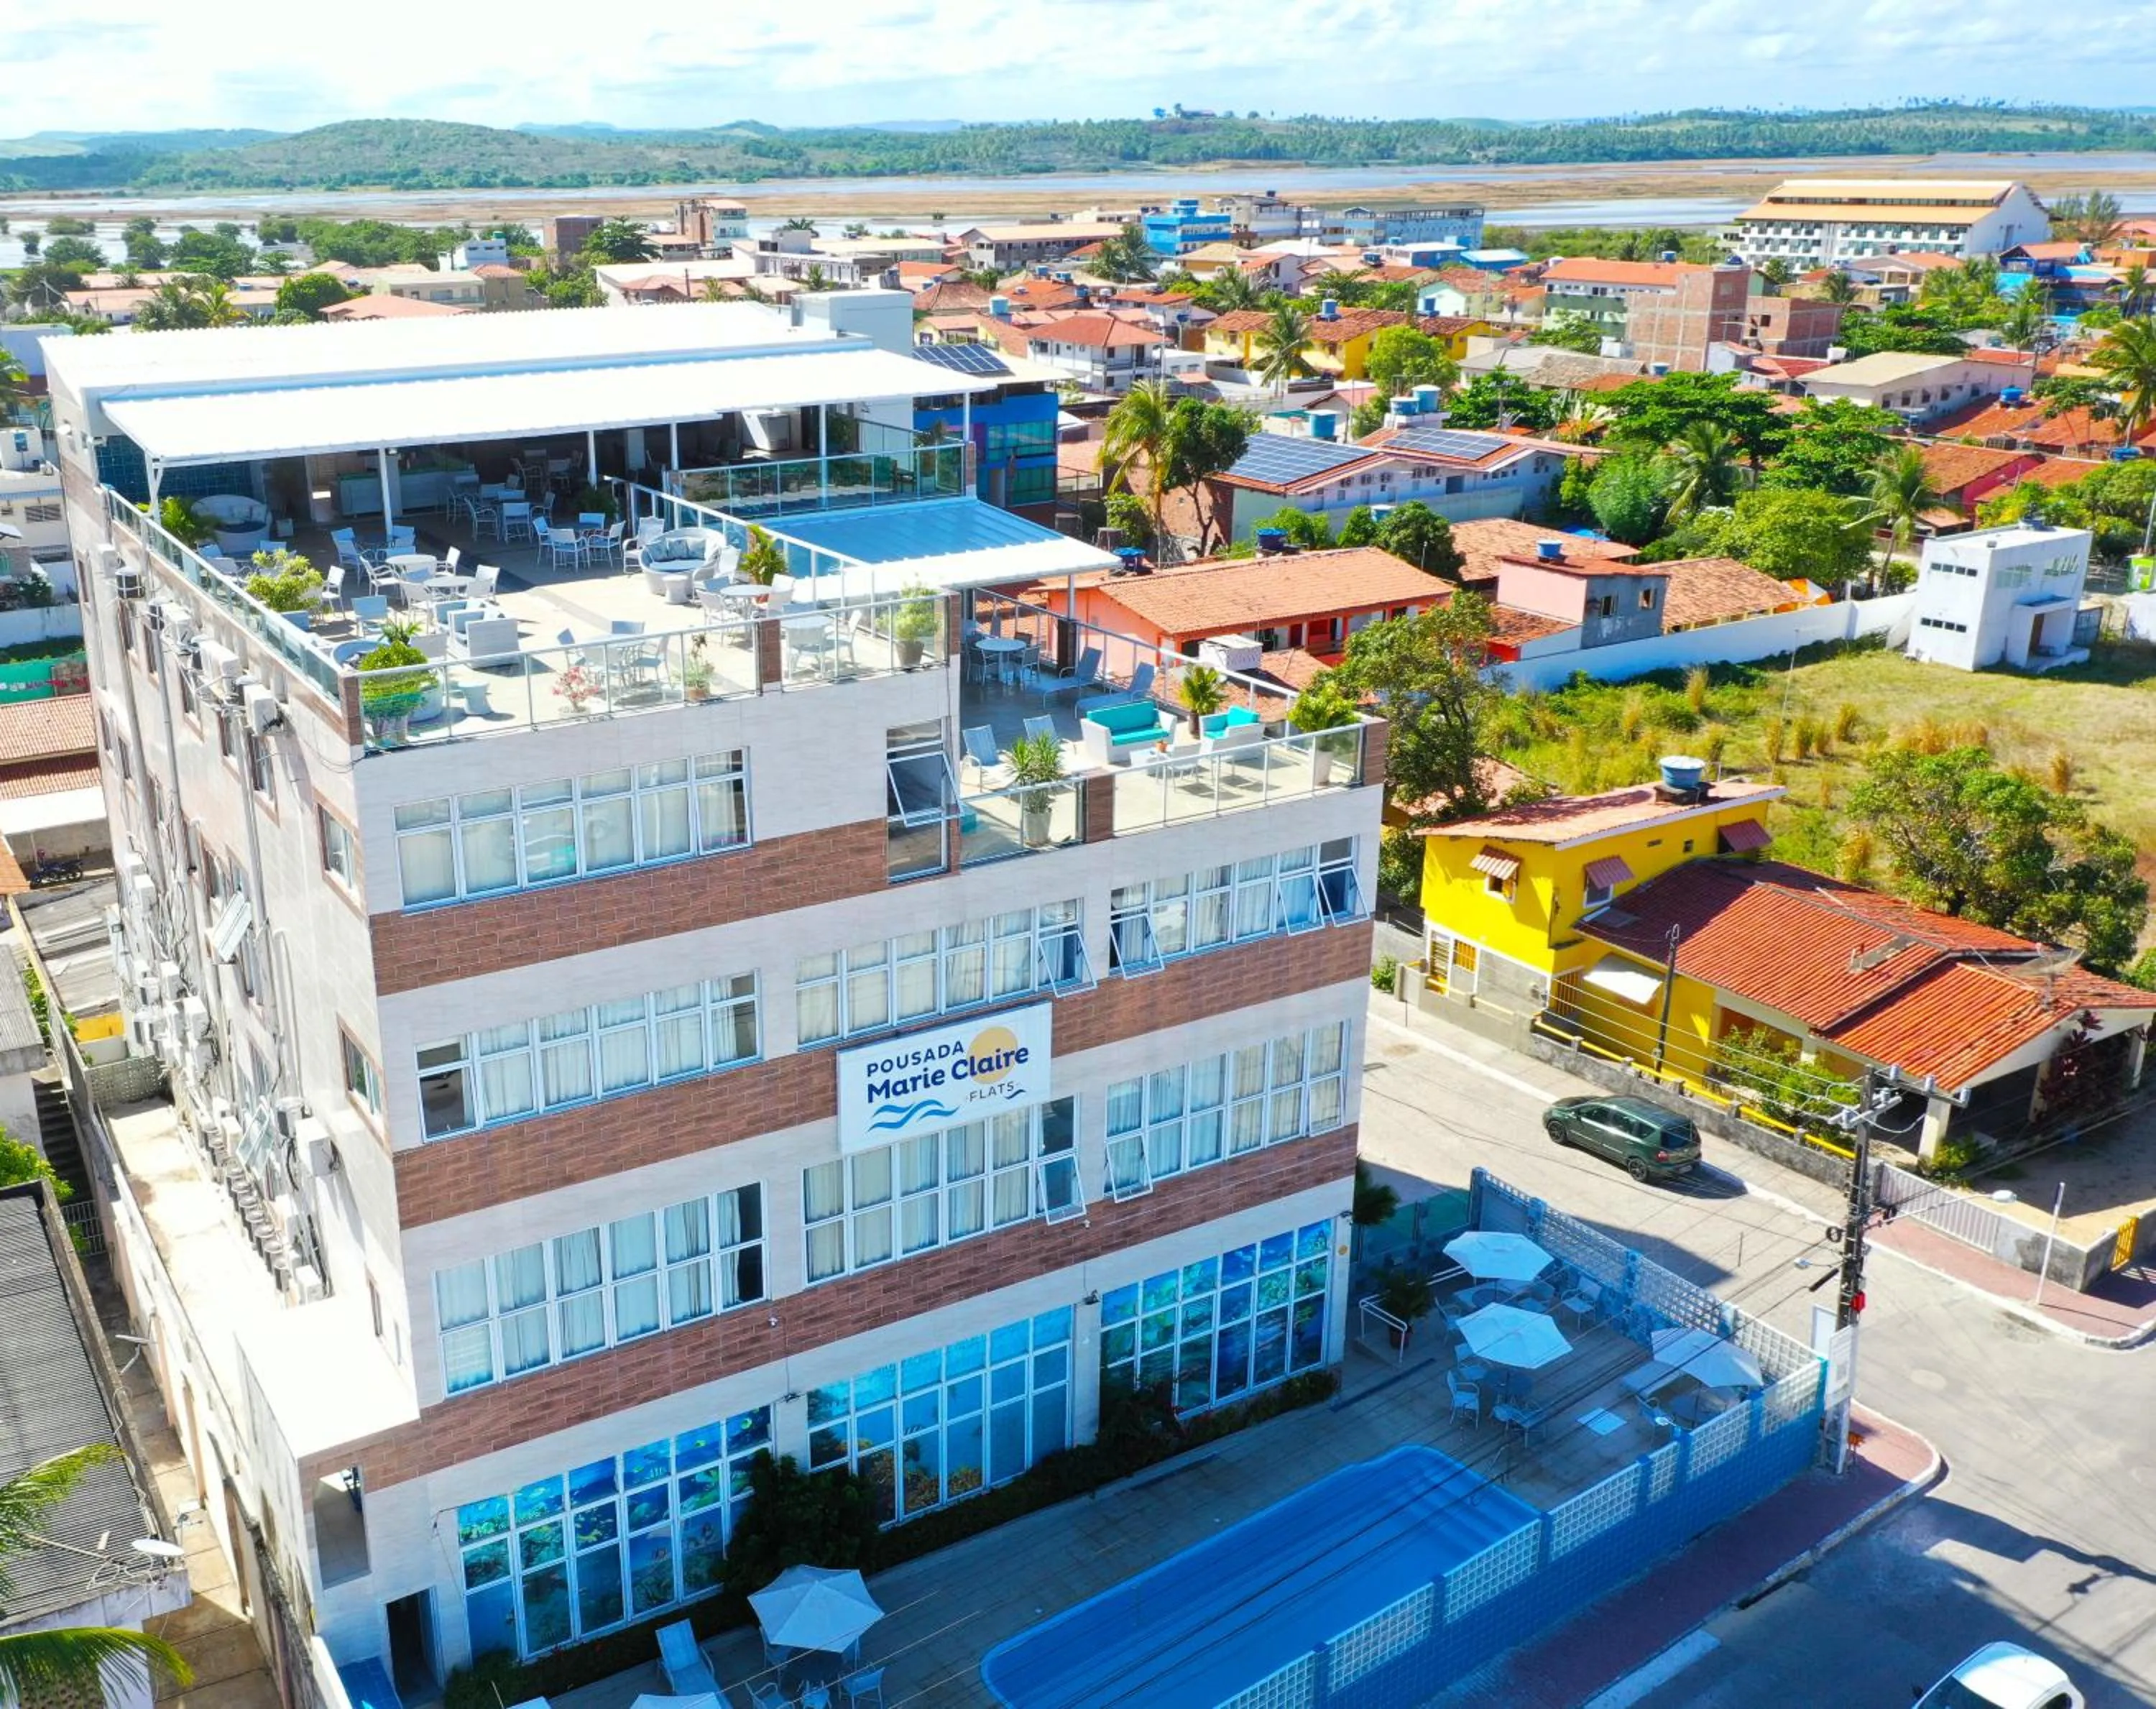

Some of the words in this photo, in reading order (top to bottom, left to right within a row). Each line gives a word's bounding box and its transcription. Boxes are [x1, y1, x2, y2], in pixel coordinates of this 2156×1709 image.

[867, 1041, 964, 1077] POUSADA
[867, 1067, 945, 1103] Marie
[951, 1046, 1029, 1080] Claire
[969, 1081, 1014, 1102] FLATS
